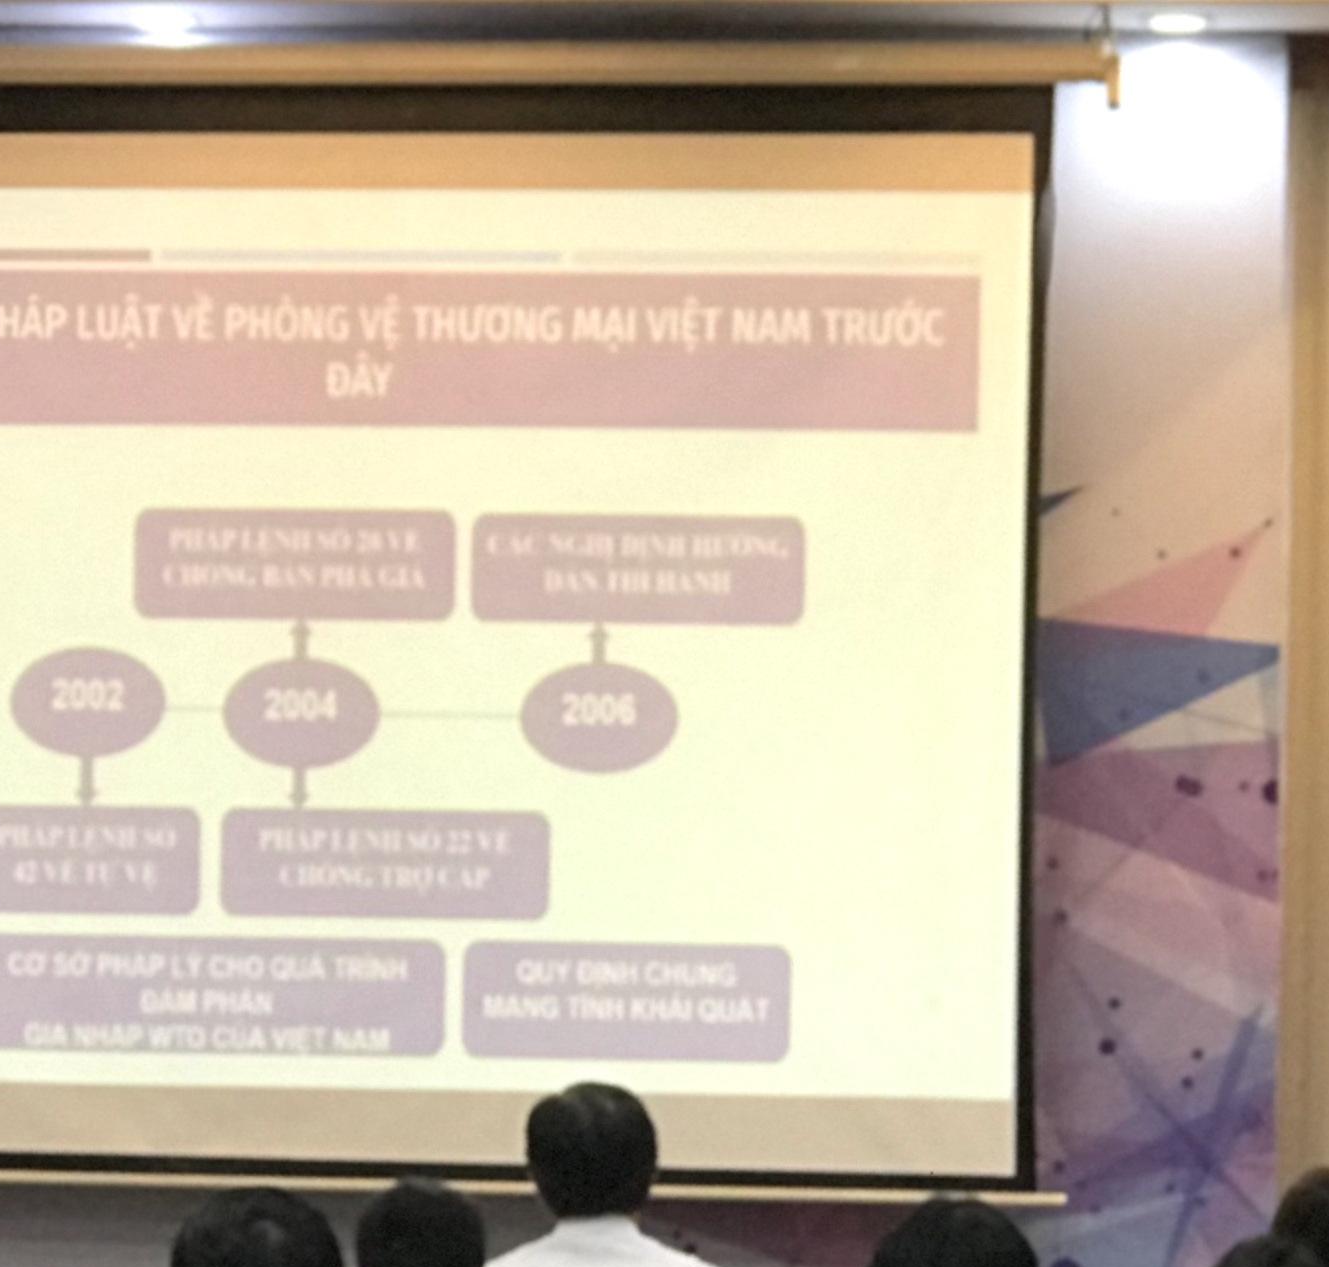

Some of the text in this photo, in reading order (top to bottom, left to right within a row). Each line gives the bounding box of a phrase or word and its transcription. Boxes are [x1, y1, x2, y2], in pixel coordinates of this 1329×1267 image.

[77, 292, 163, 351] LUẬT
[172, 290, 214, 341] VỀ
[358, 294, 402, 351] VỆ
[412, 303, 563, 343] THƯƠNG
[573, 305, 636, 353] MẠI
[645, 295, 724, 355] VIỆT
[731, 306, 811, 344] NAM
[822, 299, 946, 347] TRƯỚC
[324, 350, 394, 398] ĐÂY
[51, 678, 125, 712] 2002
[264, 688, 337, 722] 2004
[561, 693, 637, 727] 2006
[207, 953, 264, 980] CHO
[644, 960, 738, 989] CHUNG
[481, 993, 560, 1021] MANG
[22, 1022, 68, 1046] GIA
[148, 1026, 206, 1048] WTO
[332, 1027, 391, 1050] NAM
